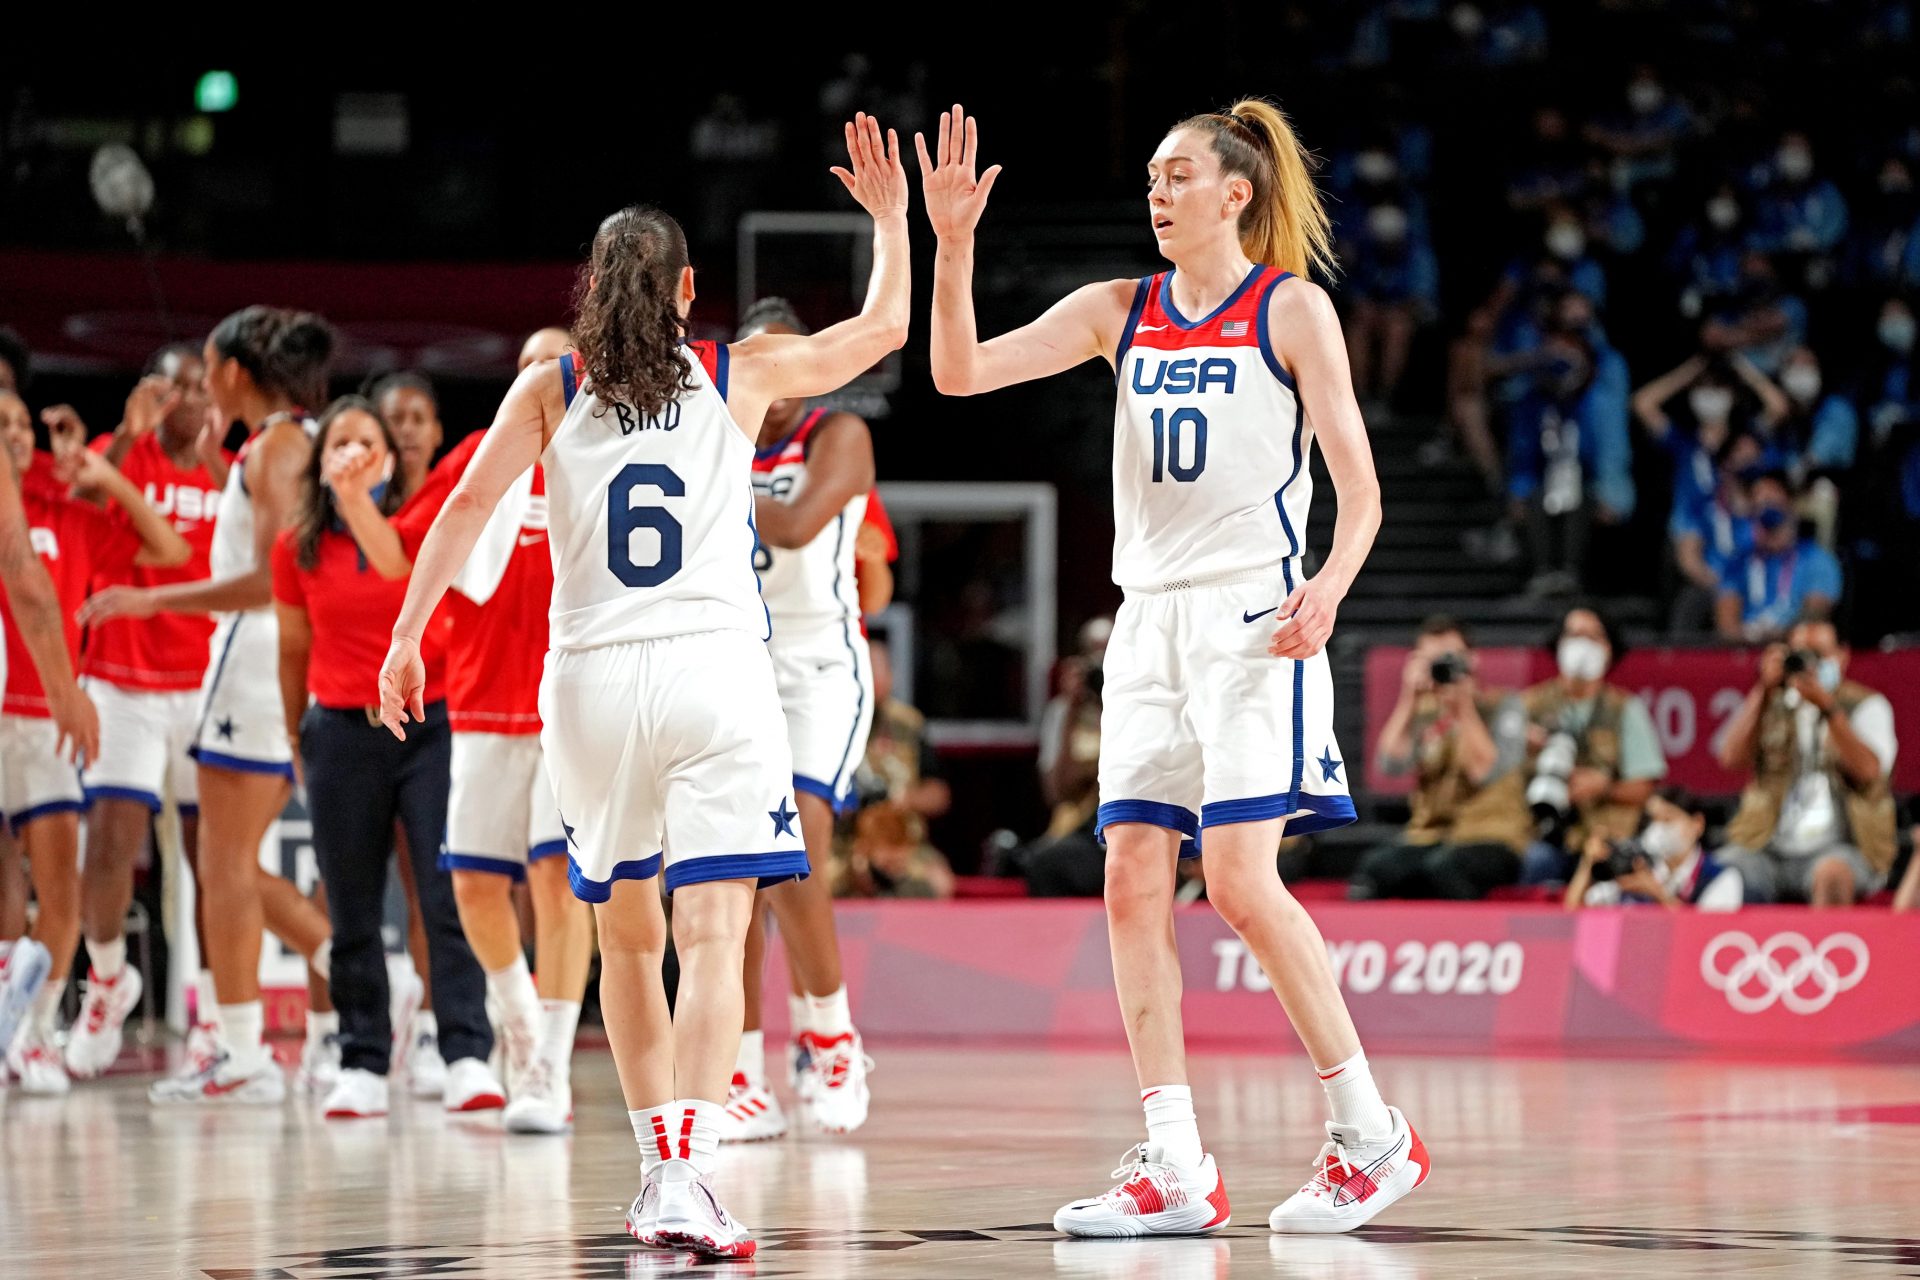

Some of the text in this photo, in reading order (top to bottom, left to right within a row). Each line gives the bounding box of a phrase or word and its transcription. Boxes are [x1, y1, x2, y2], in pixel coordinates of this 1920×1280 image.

[1131, 357, 1237, 395] USA
[1150, 407, 1208, 483] 10
[607, 463, 686, 588] 6
[1211, 939, 1525, 994] TOYO 2020
